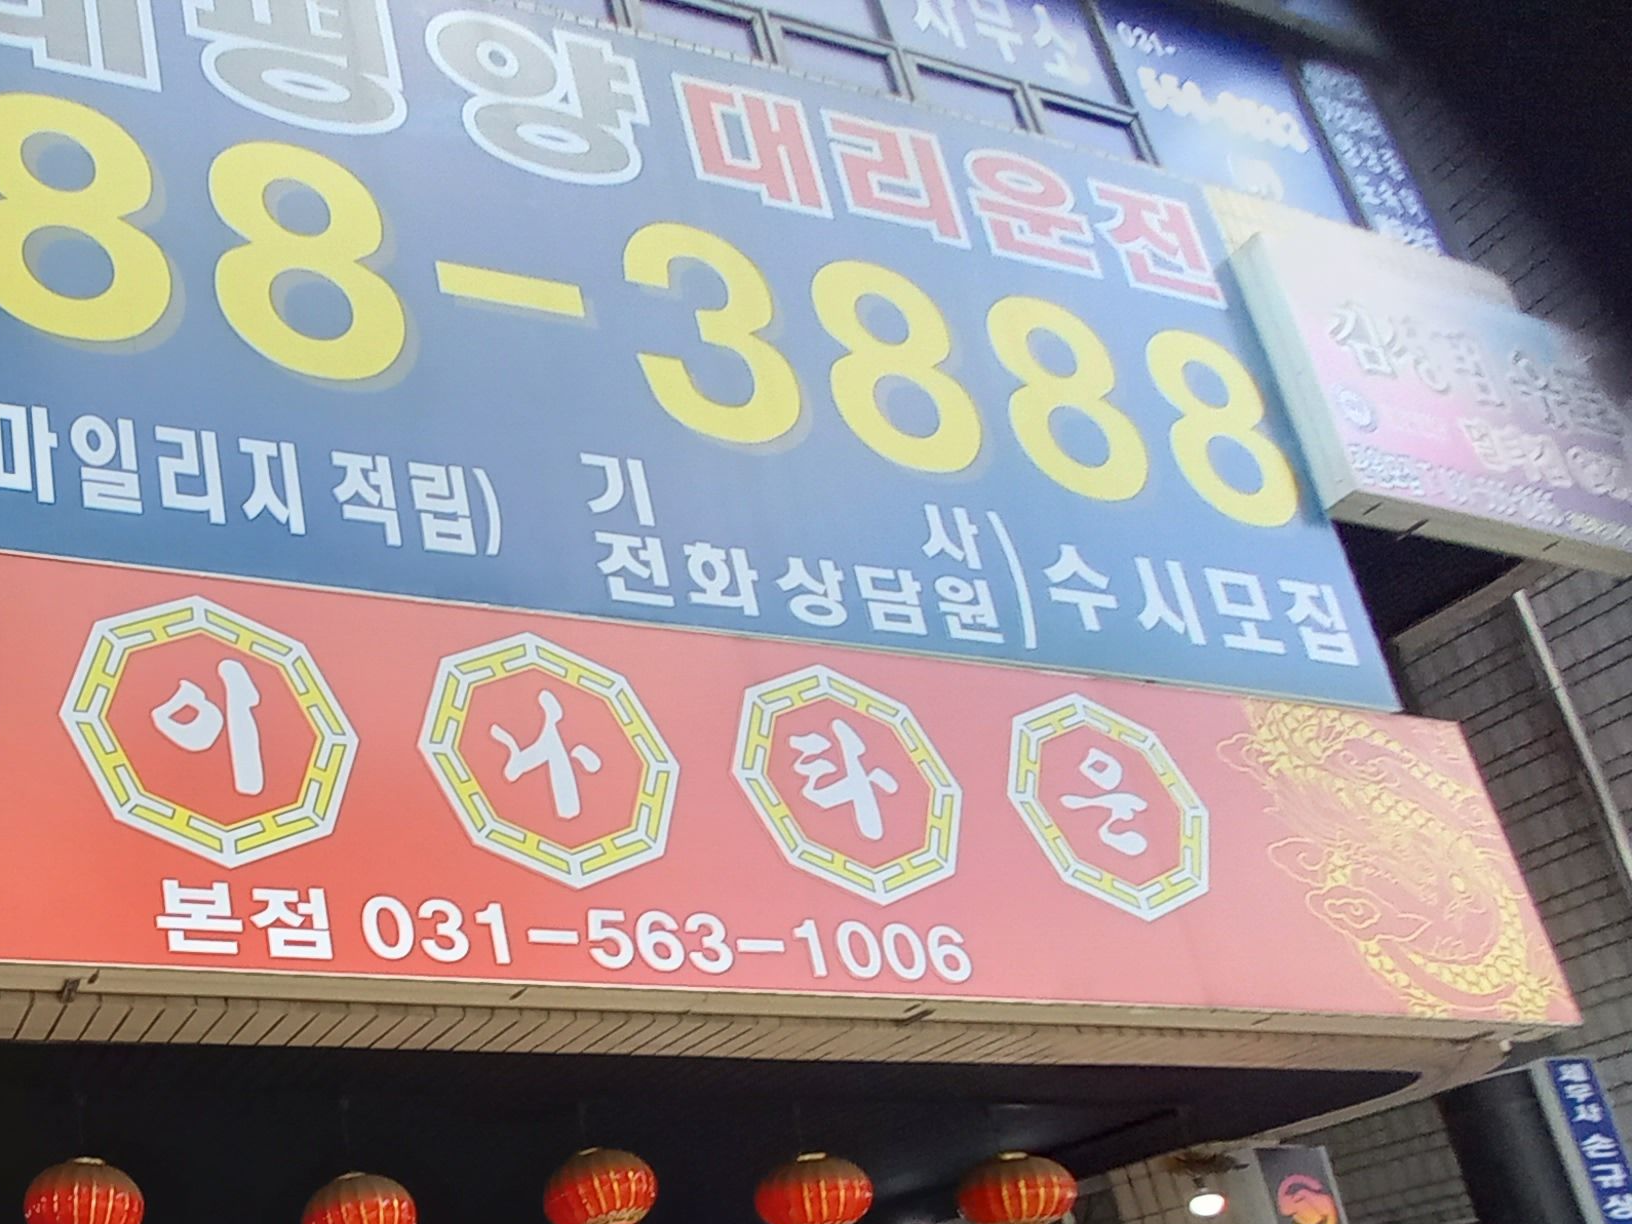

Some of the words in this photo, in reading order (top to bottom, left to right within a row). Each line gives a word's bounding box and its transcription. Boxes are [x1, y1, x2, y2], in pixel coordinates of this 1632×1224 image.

[671, 72, 1227, 310] 대리운전
[331, 450, 502, 556] 적립)
[155, 878, 334, 961] 본점
[360, 894, 974, 984] 031-563-1006
